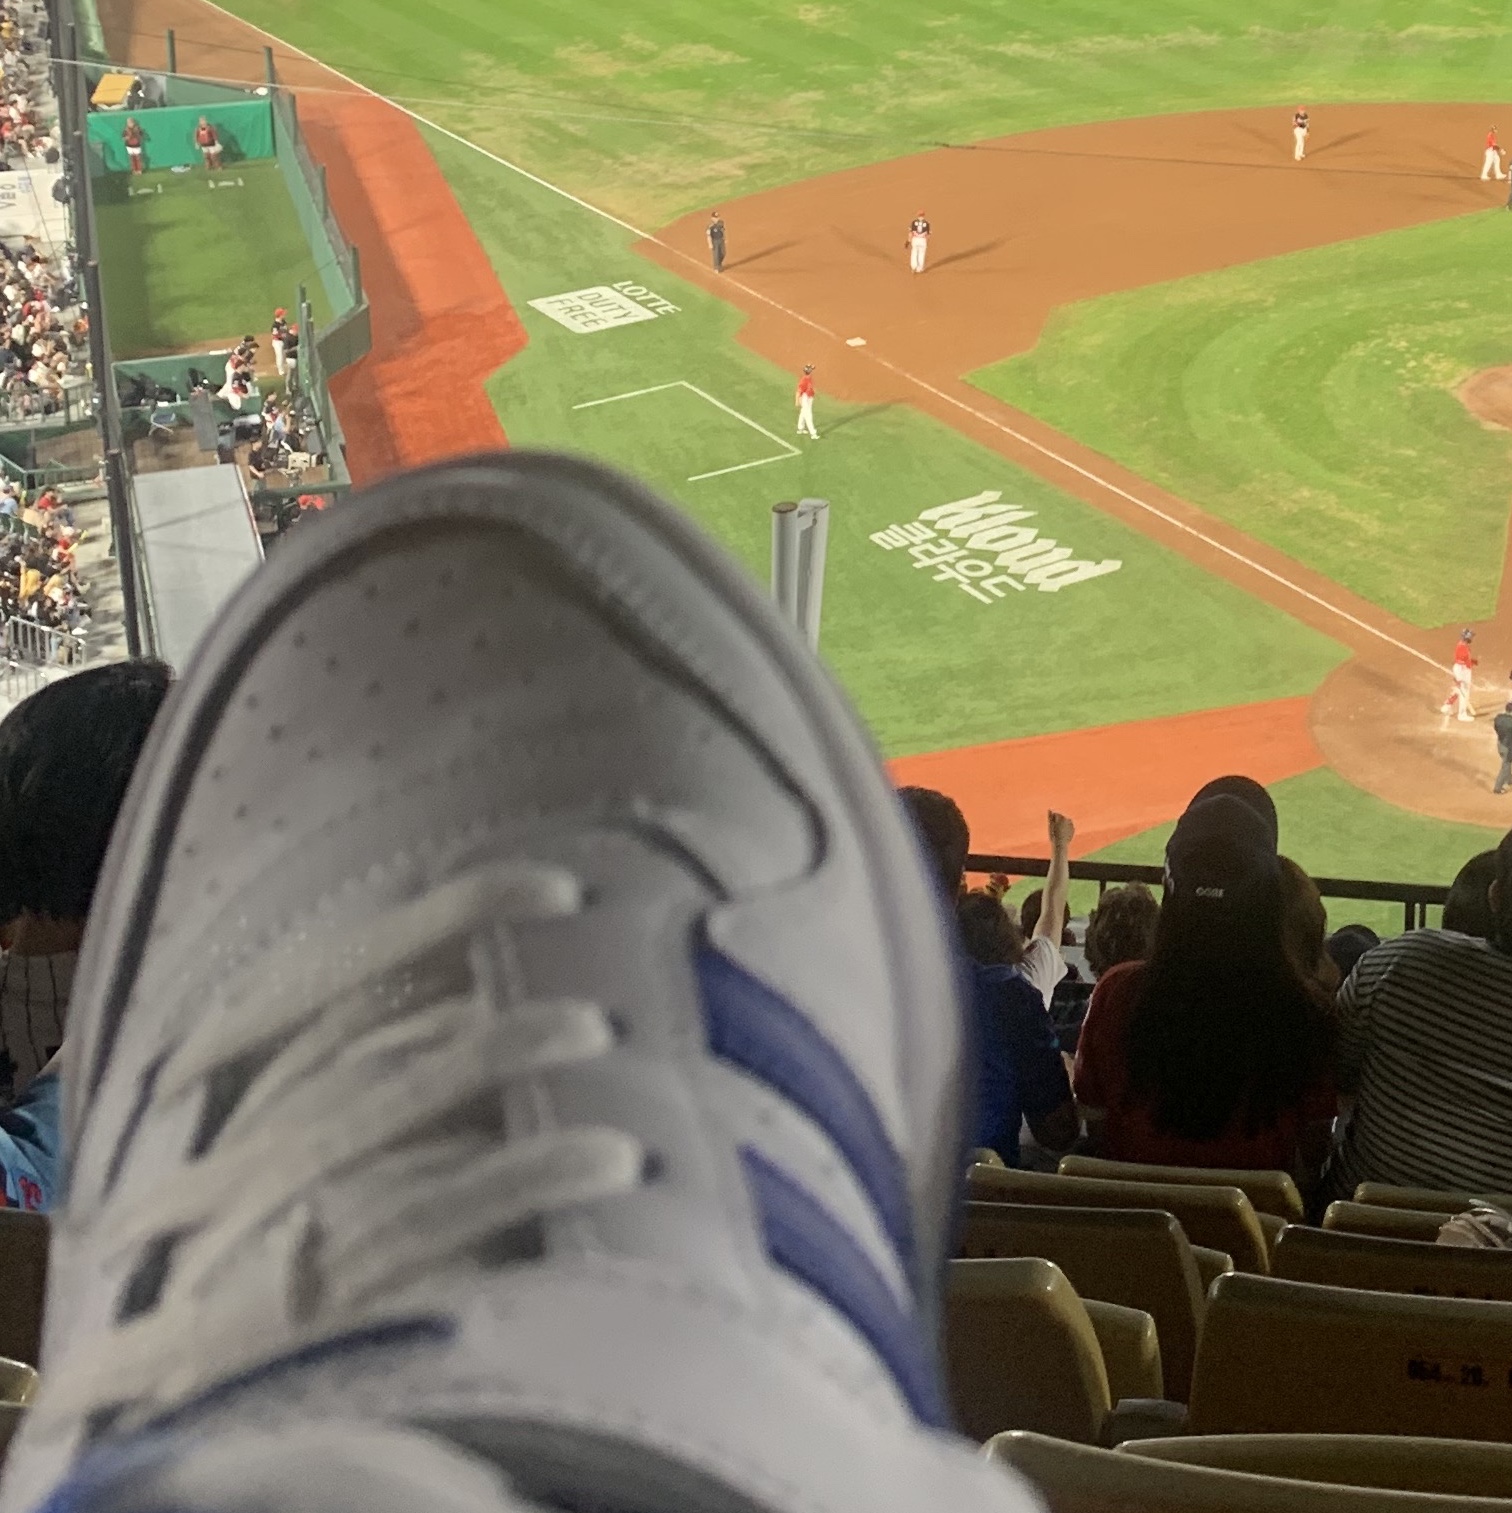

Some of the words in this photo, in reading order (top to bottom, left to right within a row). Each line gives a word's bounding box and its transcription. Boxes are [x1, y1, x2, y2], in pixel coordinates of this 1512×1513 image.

[547, 298, 610, 327] FREE
[577, 292, 639, 320] DUTY
[612, 280, 682, 315] LOTTE
[869, 521, 1027, 604] 클라우드
